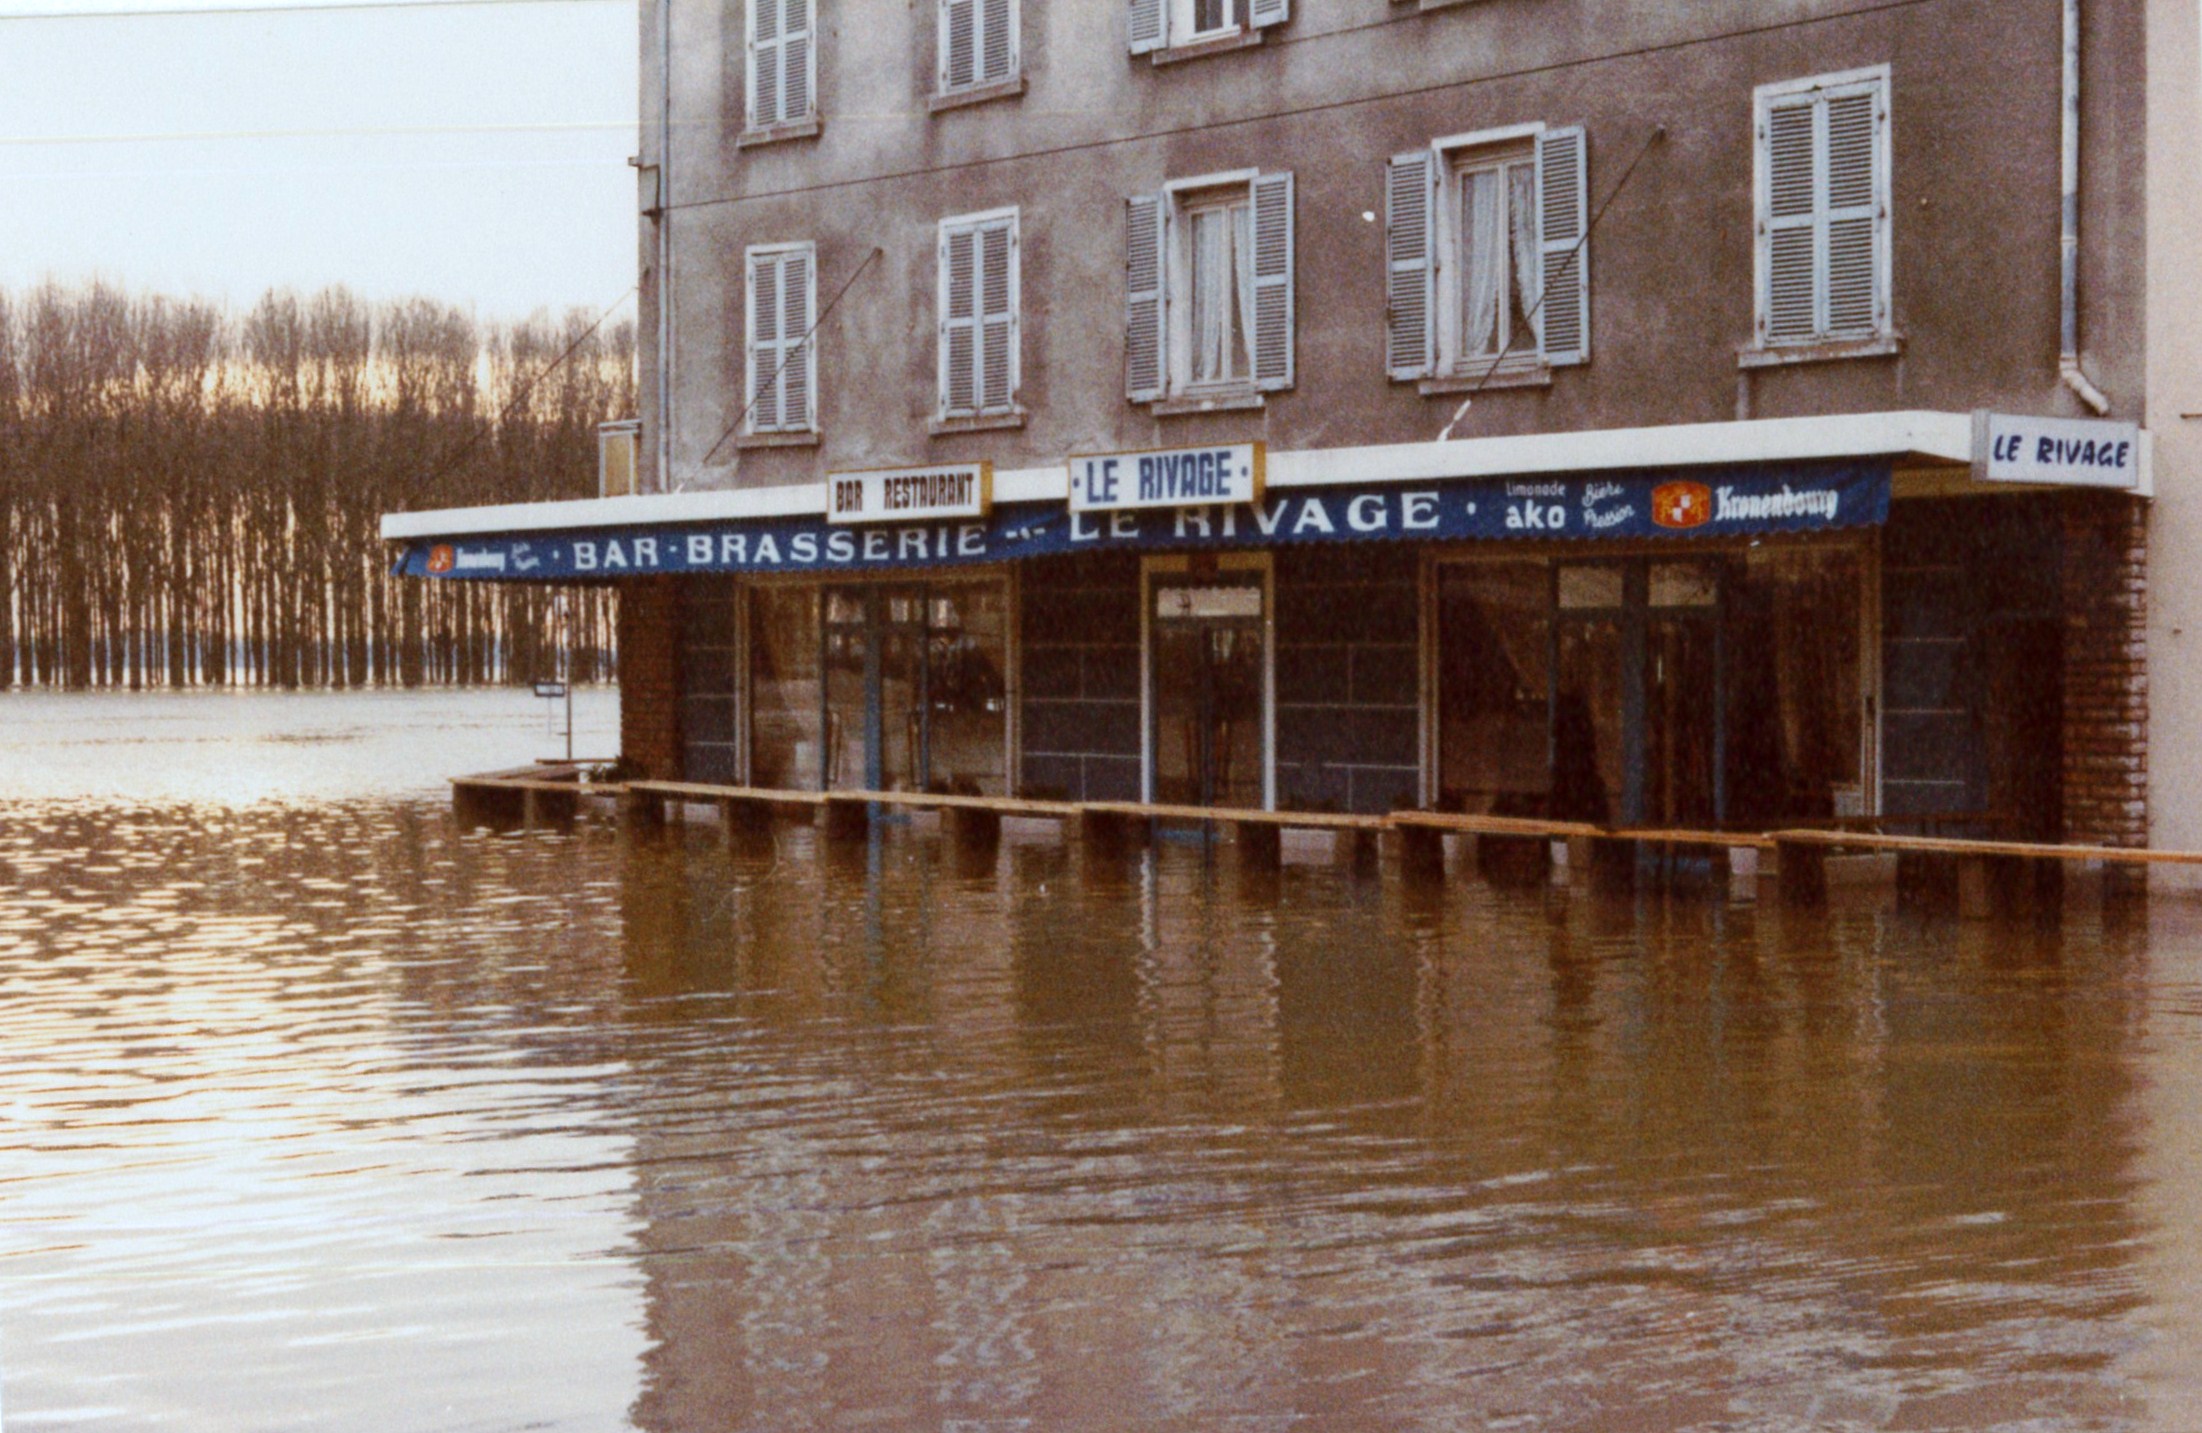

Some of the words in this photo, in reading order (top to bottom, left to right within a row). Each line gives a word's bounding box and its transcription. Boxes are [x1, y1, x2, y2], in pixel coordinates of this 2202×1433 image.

[1992, 434, 2023, 462] LE
[2035, 436, 2130, 468] RIVAGE
[836, 480, 863, 512] BAR
[884, 472, 974, 509] RESTAURANT
[1086, 459, 1119, 504] LE
[1138, 451, 1232, 500] RIVAGE
[1505, 481, 1566, 497] Limonade
[1069, 510, 1140, 541] LE
[1173, 491, 1442, 538] RIVAGE
[1505, 499, 1566, 529] ako
[1714, 483, 1839, 521] Kronenbourg
[573, 537, 660, 571] BAR
[686, 525, 987, 565] BRASSERIE
